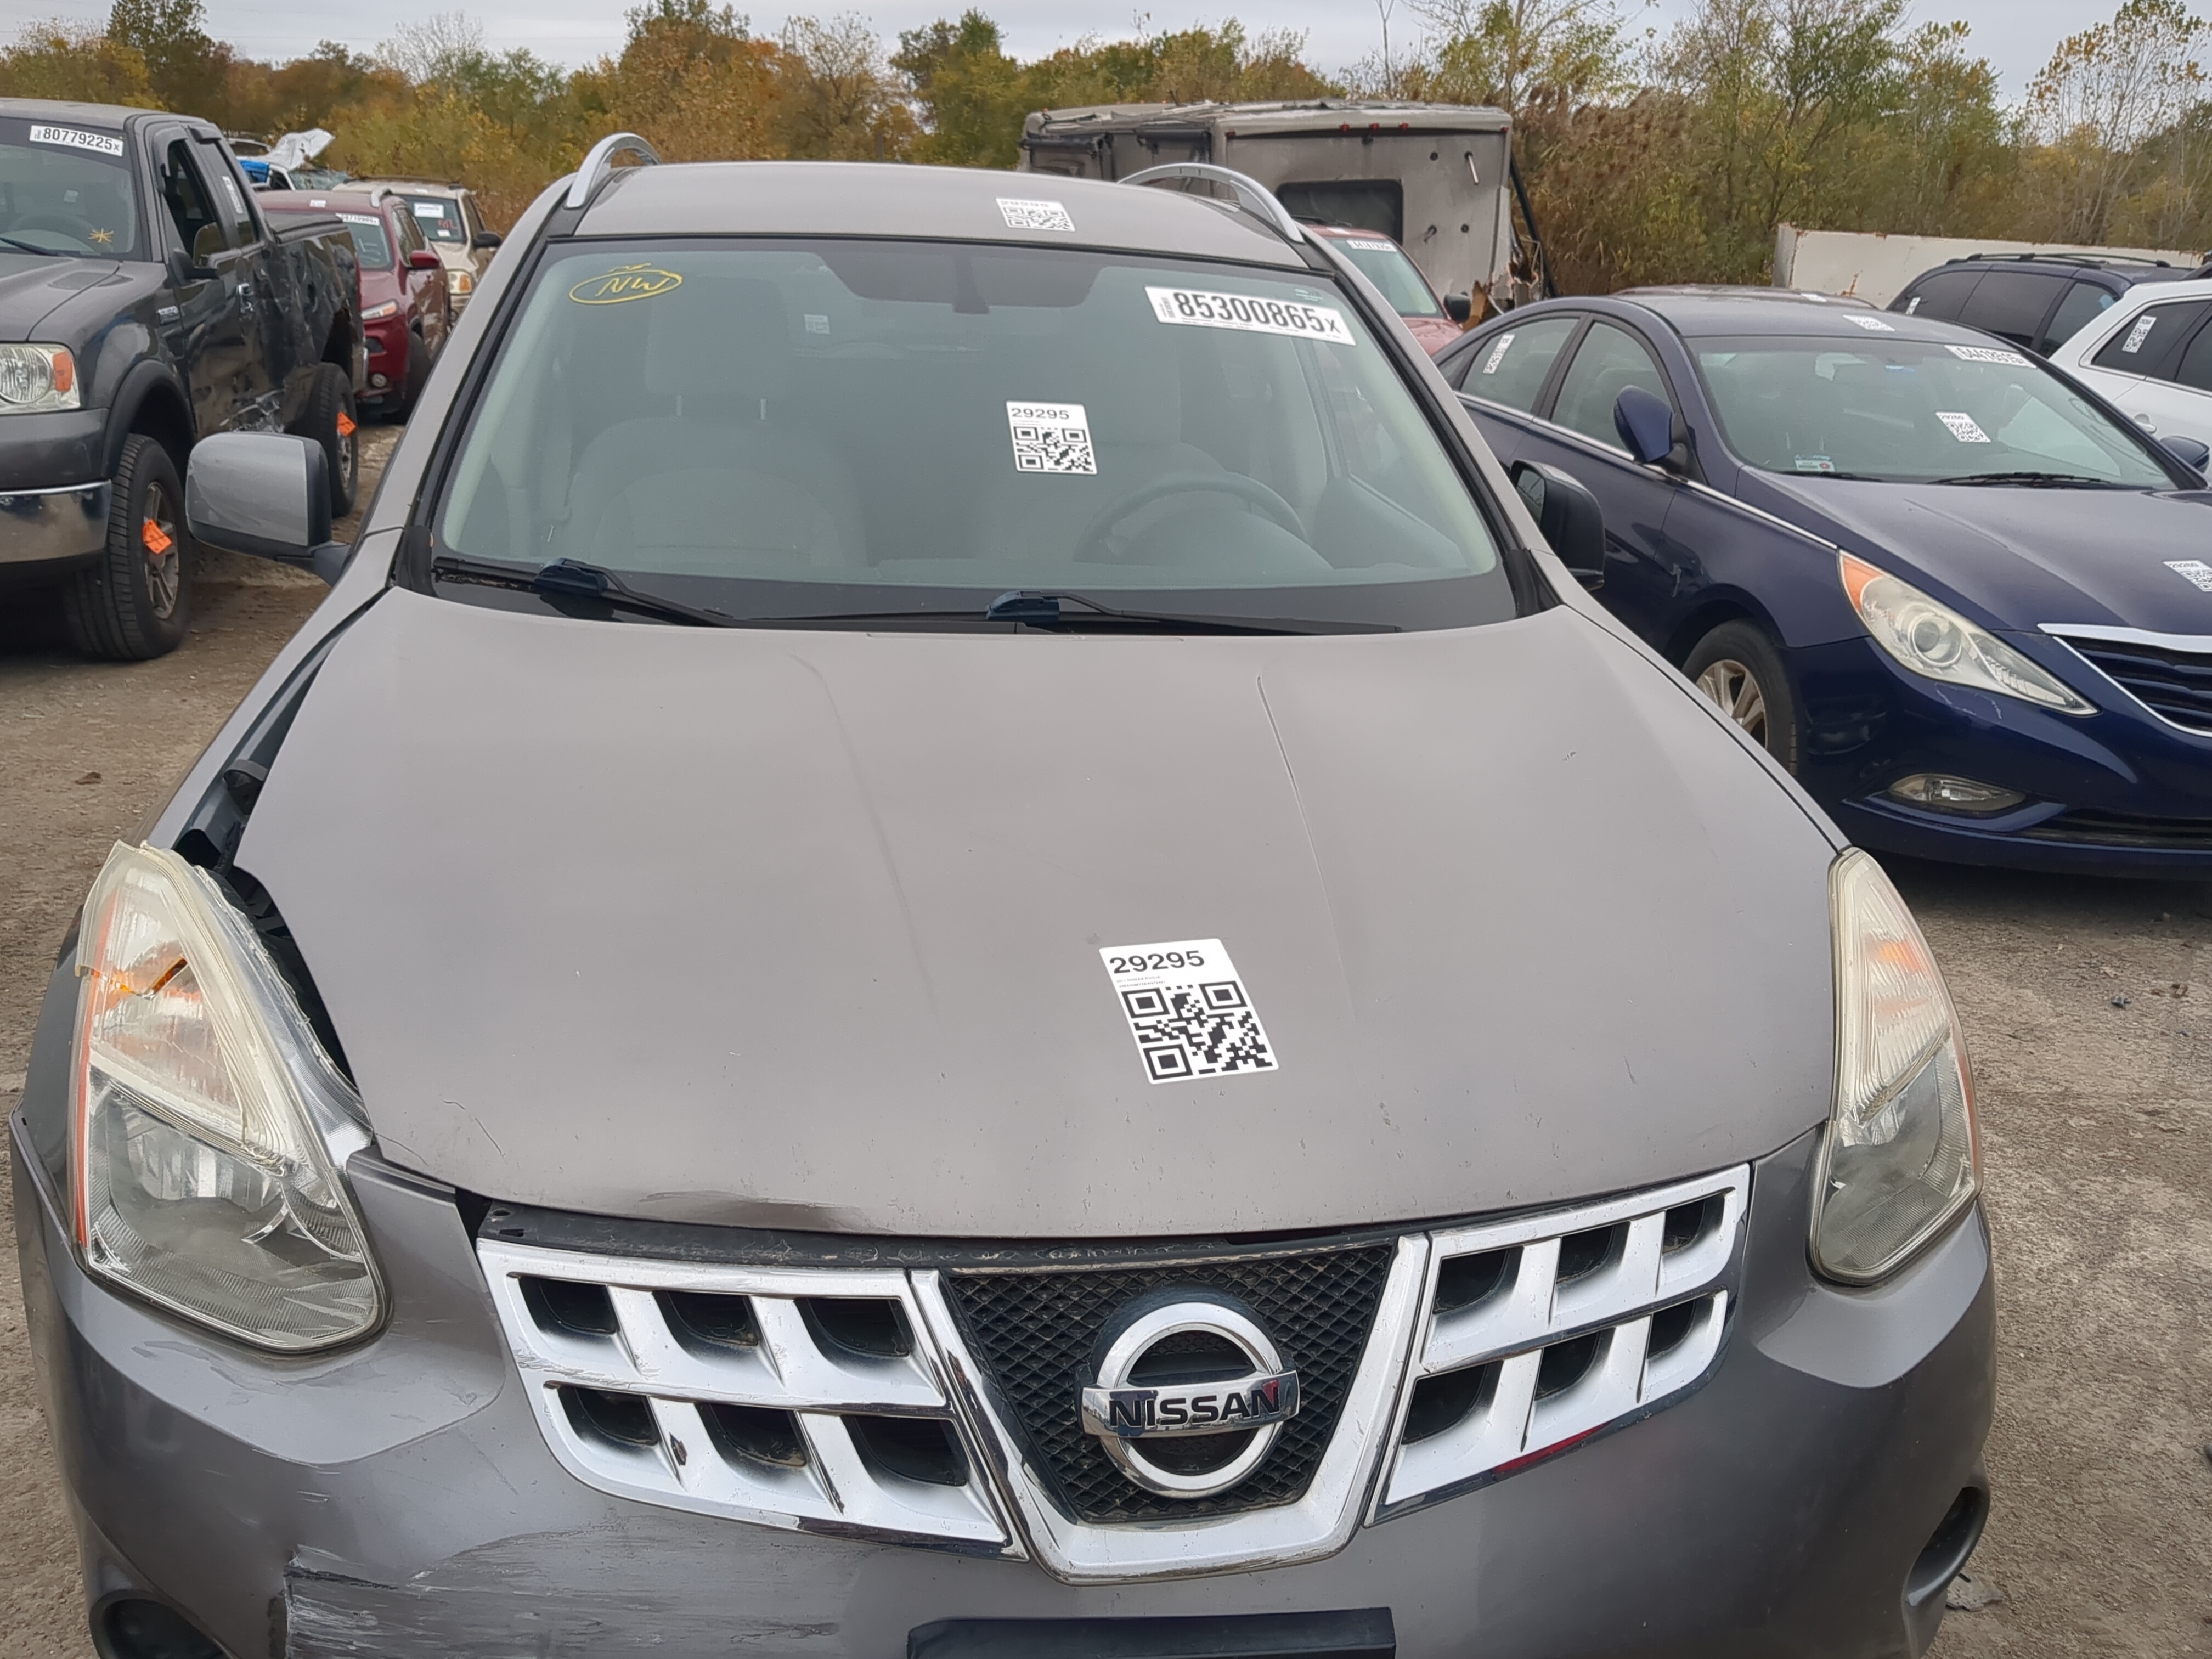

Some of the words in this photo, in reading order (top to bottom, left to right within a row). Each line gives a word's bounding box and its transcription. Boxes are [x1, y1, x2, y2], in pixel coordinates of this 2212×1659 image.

[1011, 408, 1070, 420] 29295
[1109, 950, 1205, 974] 29295
[1109, 1386, 1280, 1427] NISSAN
